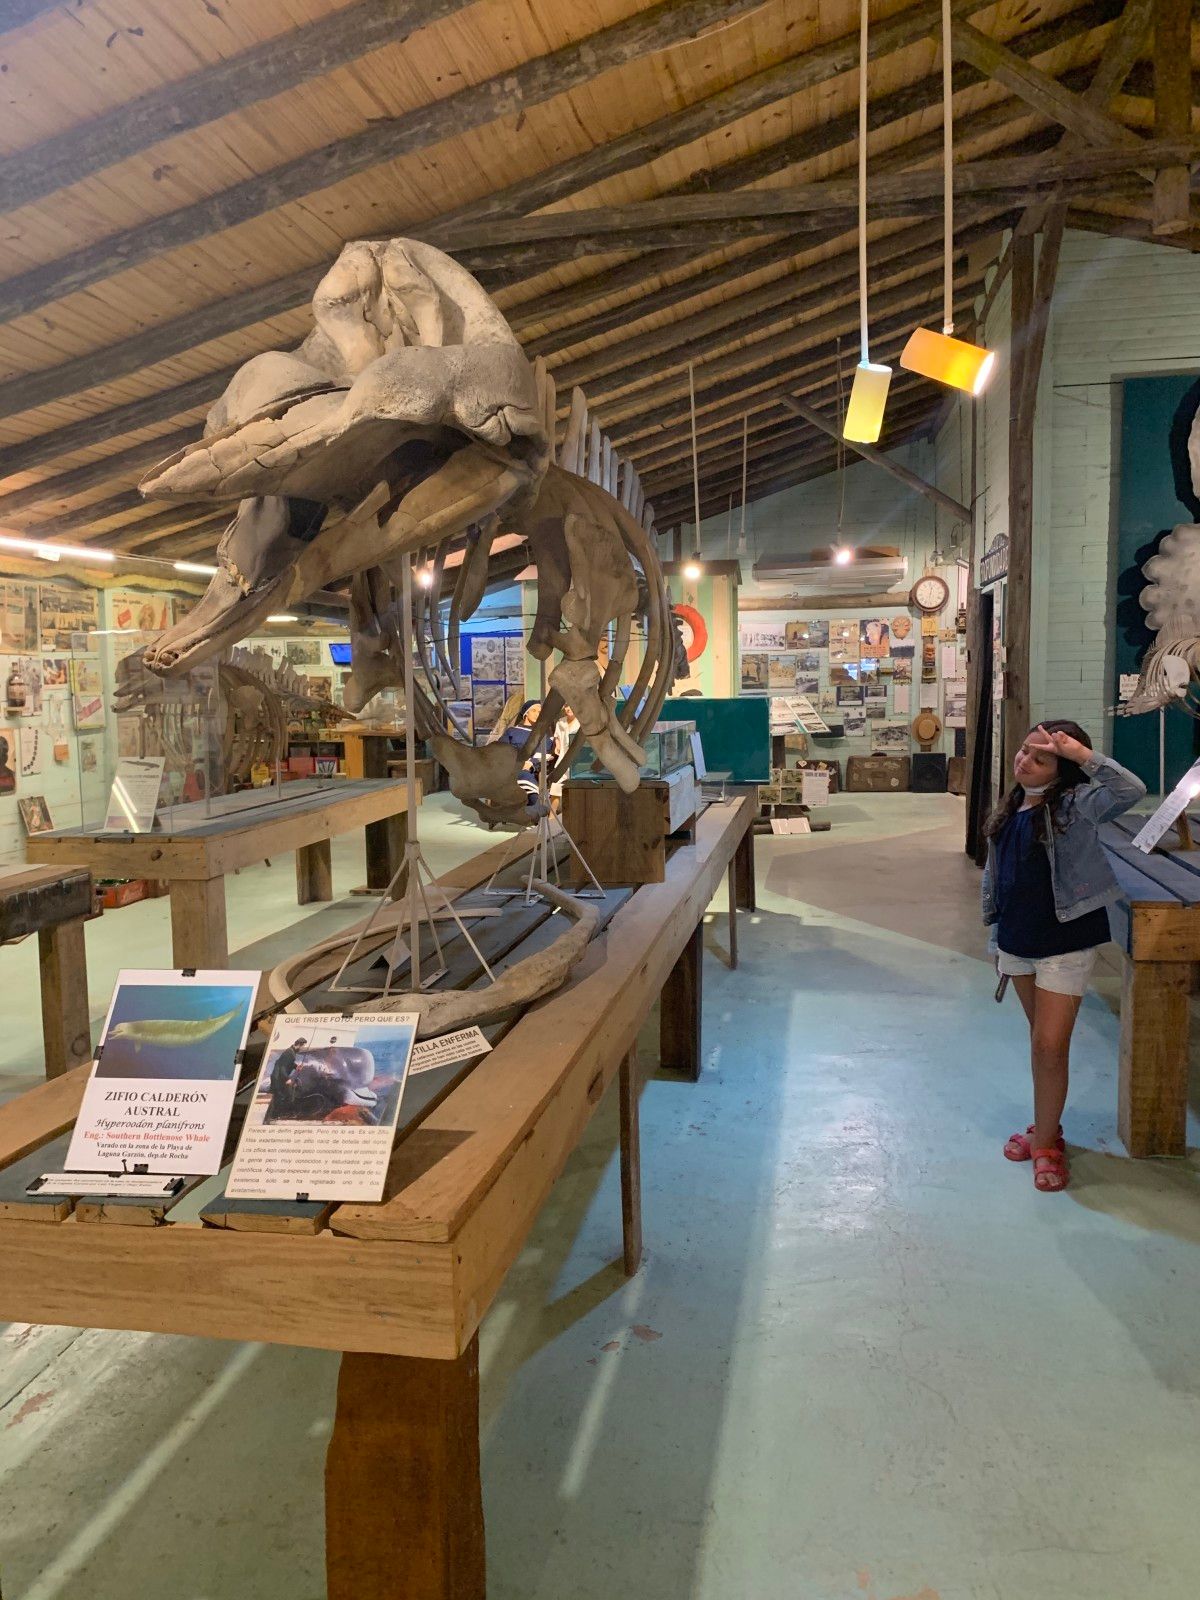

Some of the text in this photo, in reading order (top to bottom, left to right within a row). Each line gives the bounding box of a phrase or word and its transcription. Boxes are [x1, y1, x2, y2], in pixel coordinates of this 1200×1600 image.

[440, 1030, 479, 1047] ENFERMA
[105, 1091, 208, 1103] ZIFIO CALDERÓN
[124, 1106, 180, 1116] AUSTRAL
[95, 1119, 205, 1132] Hyperoodon planifrons
[84, 1131, 104, 1141] Eng.:
[106, 1132, 141, 1141] Southern
[144, 1133, 183, 1141] Bottlenose
